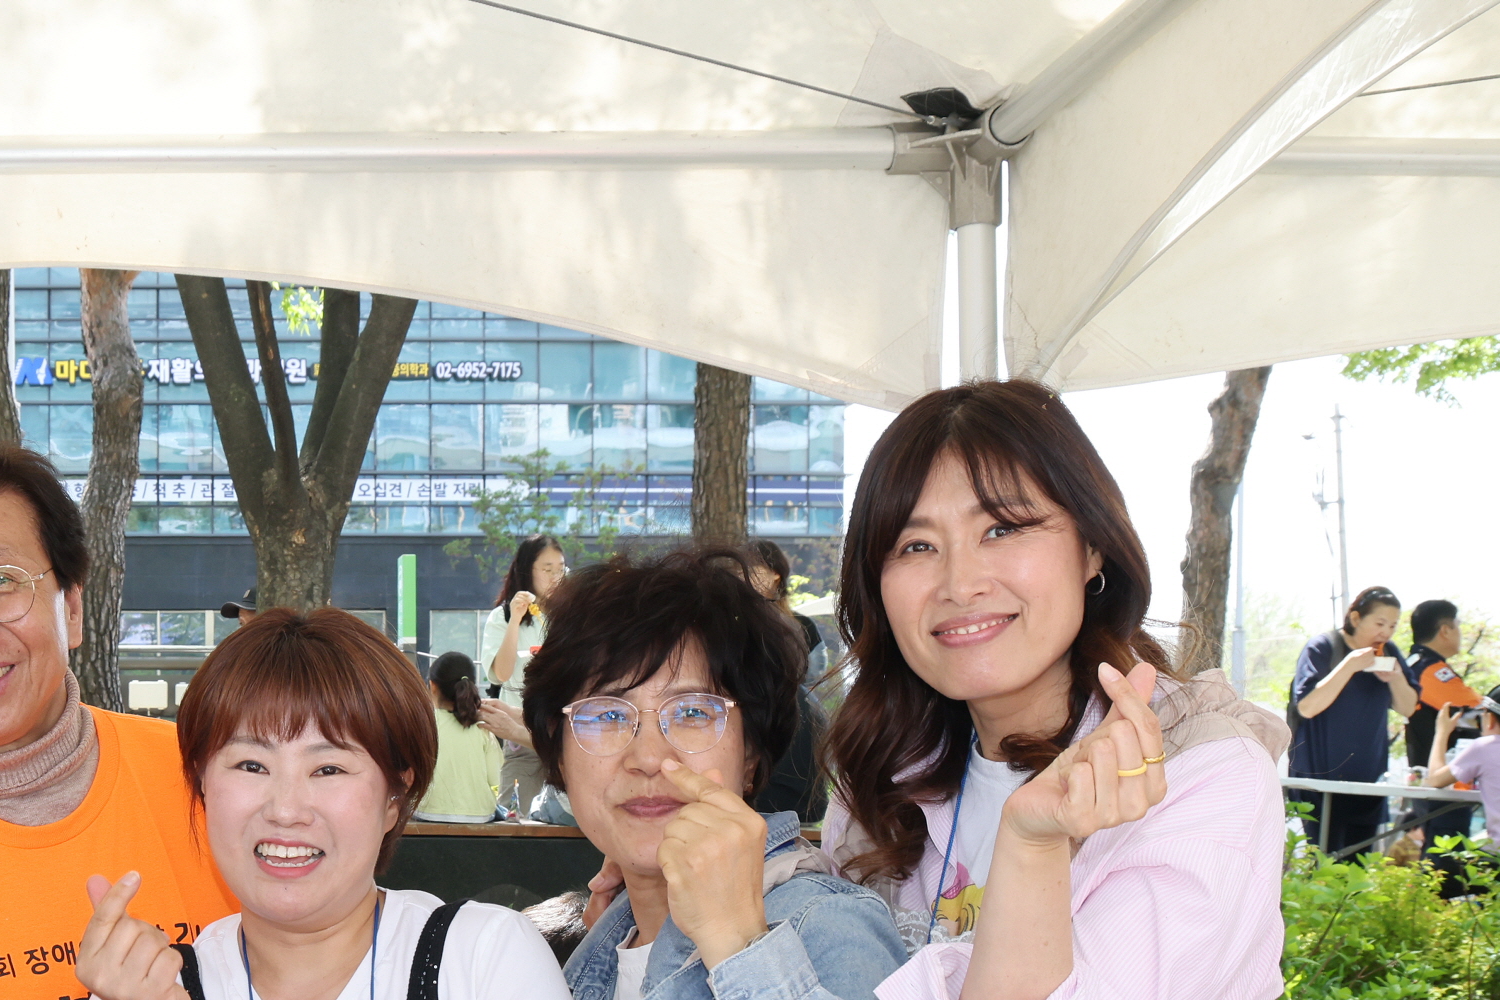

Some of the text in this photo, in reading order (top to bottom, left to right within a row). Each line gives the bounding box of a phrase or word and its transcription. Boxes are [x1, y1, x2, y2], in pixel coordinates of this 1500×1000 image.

[435, 361, 521, 378] 02-6952-7175
[358, 482, 402, 498] 오십견
[417, 482, 448, 498] 손발
